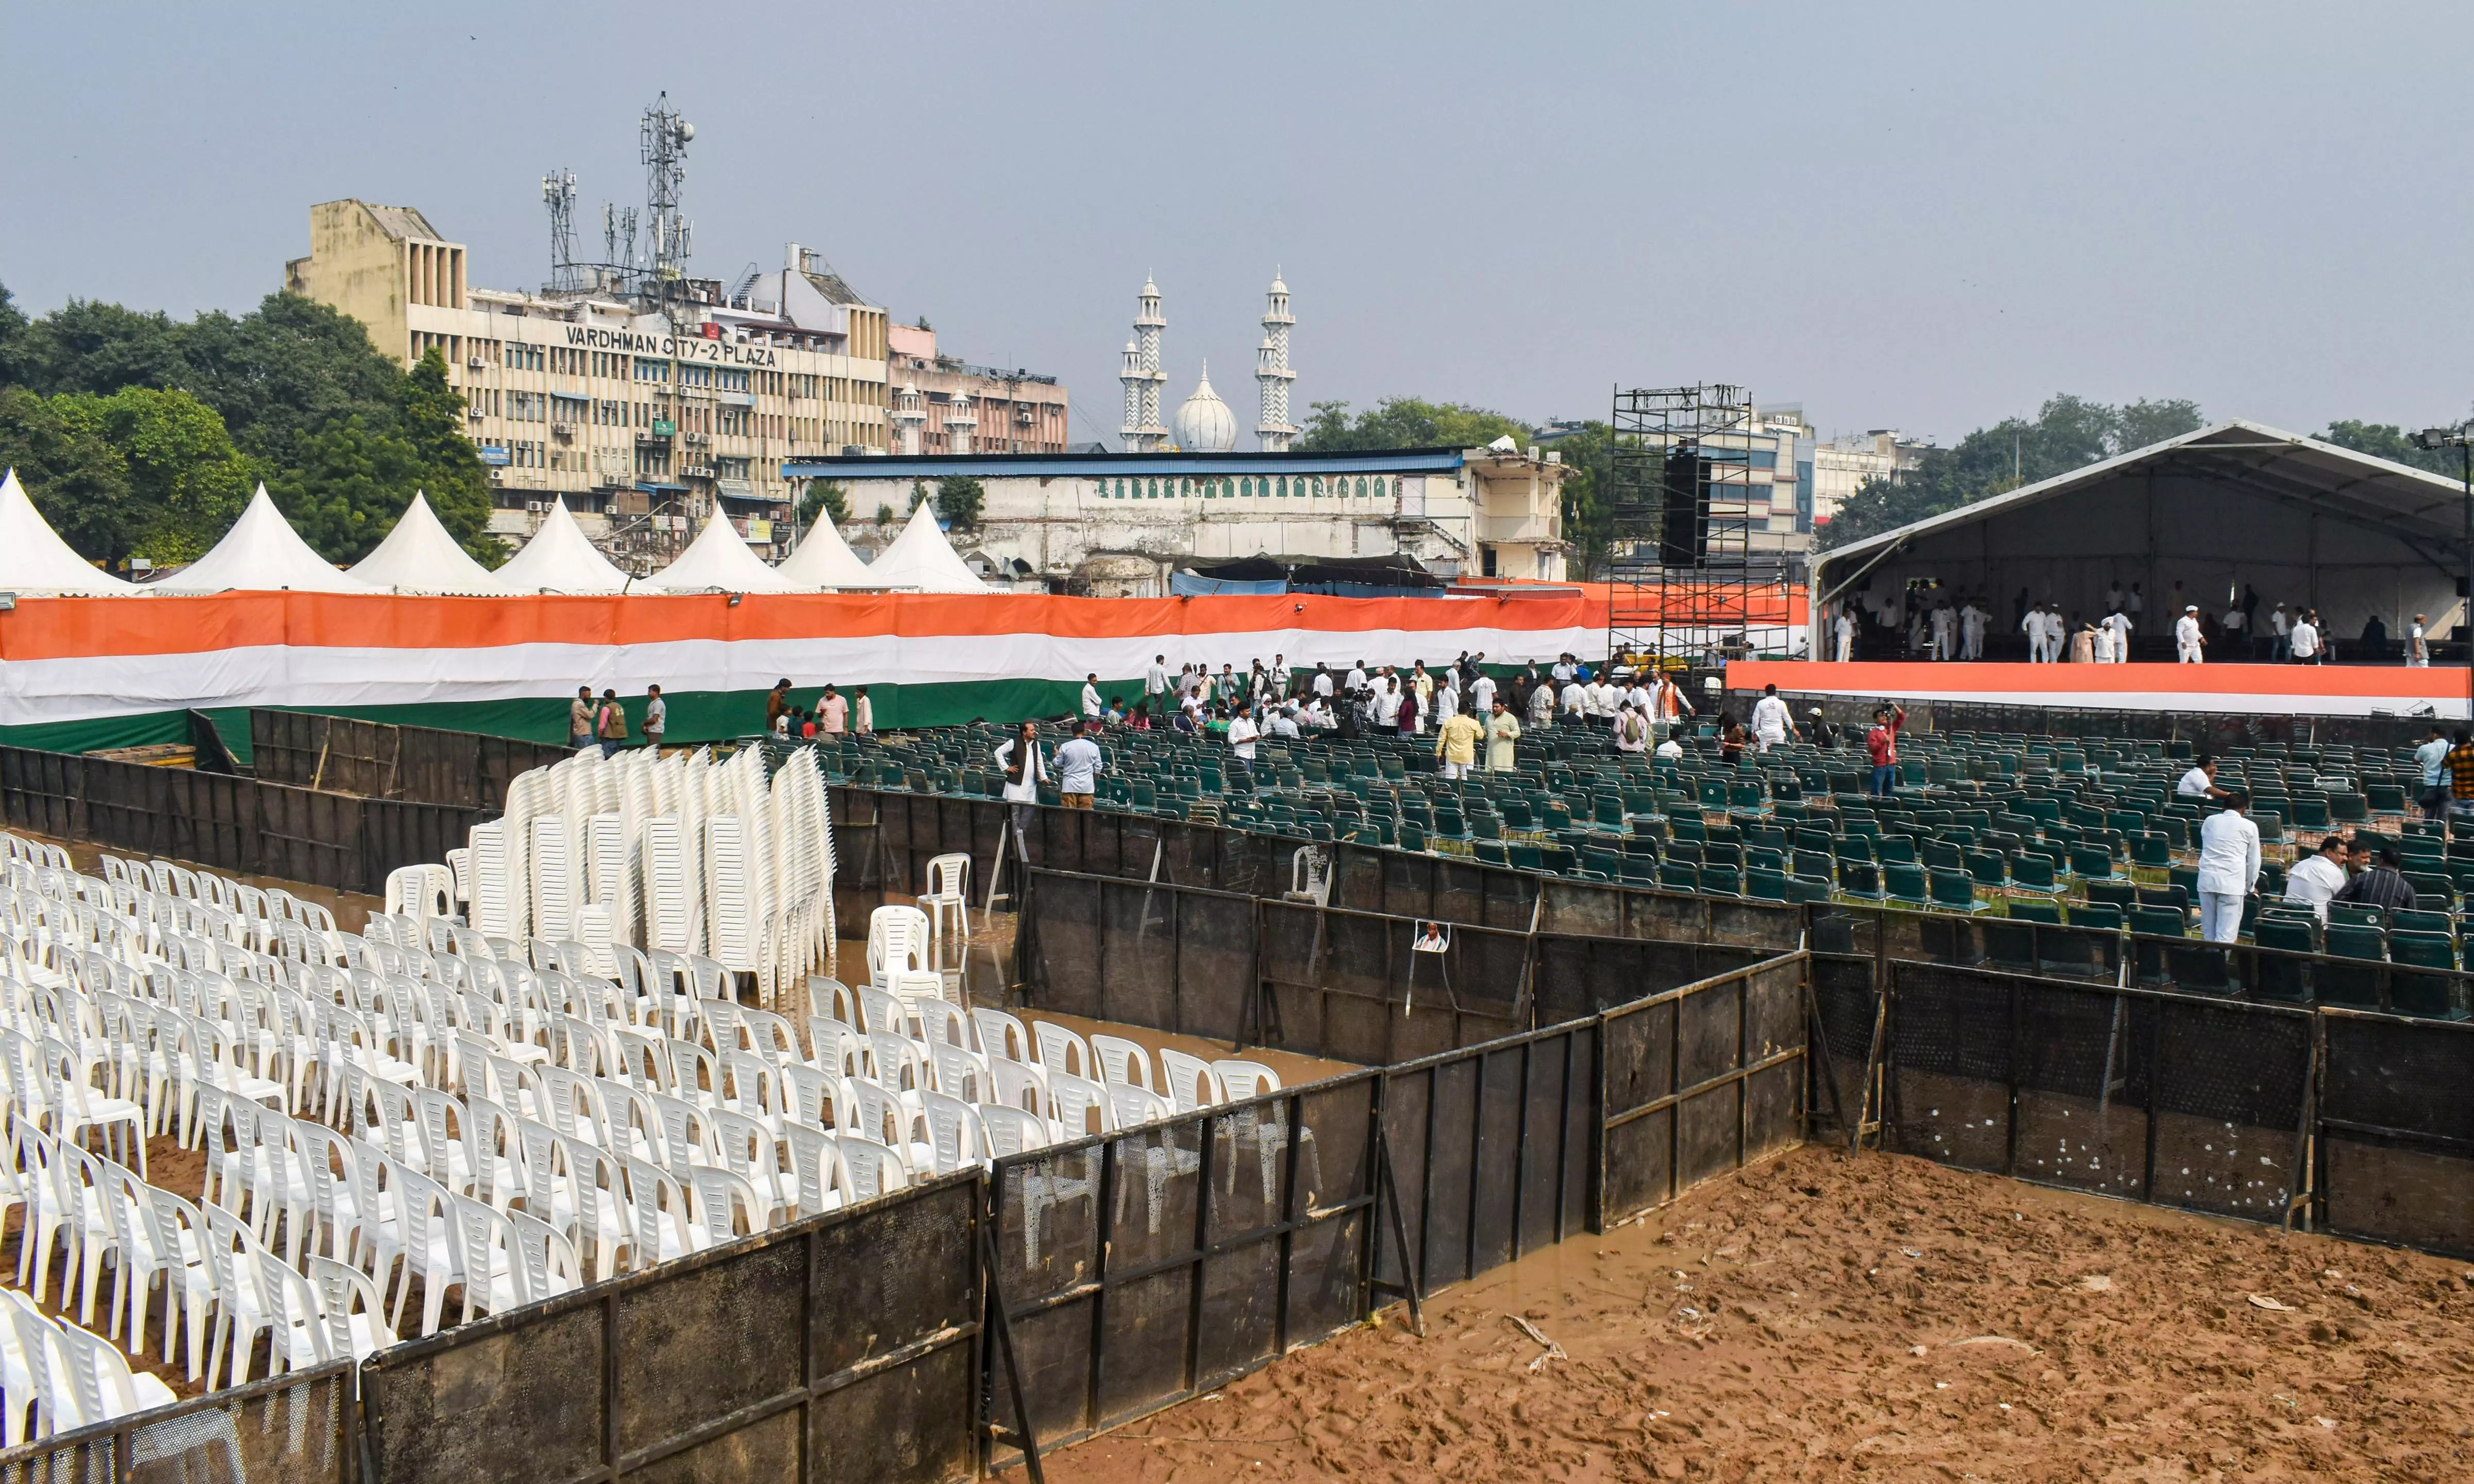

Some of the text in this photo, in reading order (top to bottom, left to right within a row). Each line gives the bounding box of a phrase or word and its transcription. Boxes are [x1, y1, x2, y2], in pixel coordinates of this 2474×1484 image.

[566, 325, 776, 367] VARDHMAN CITY-2 PLAZA
